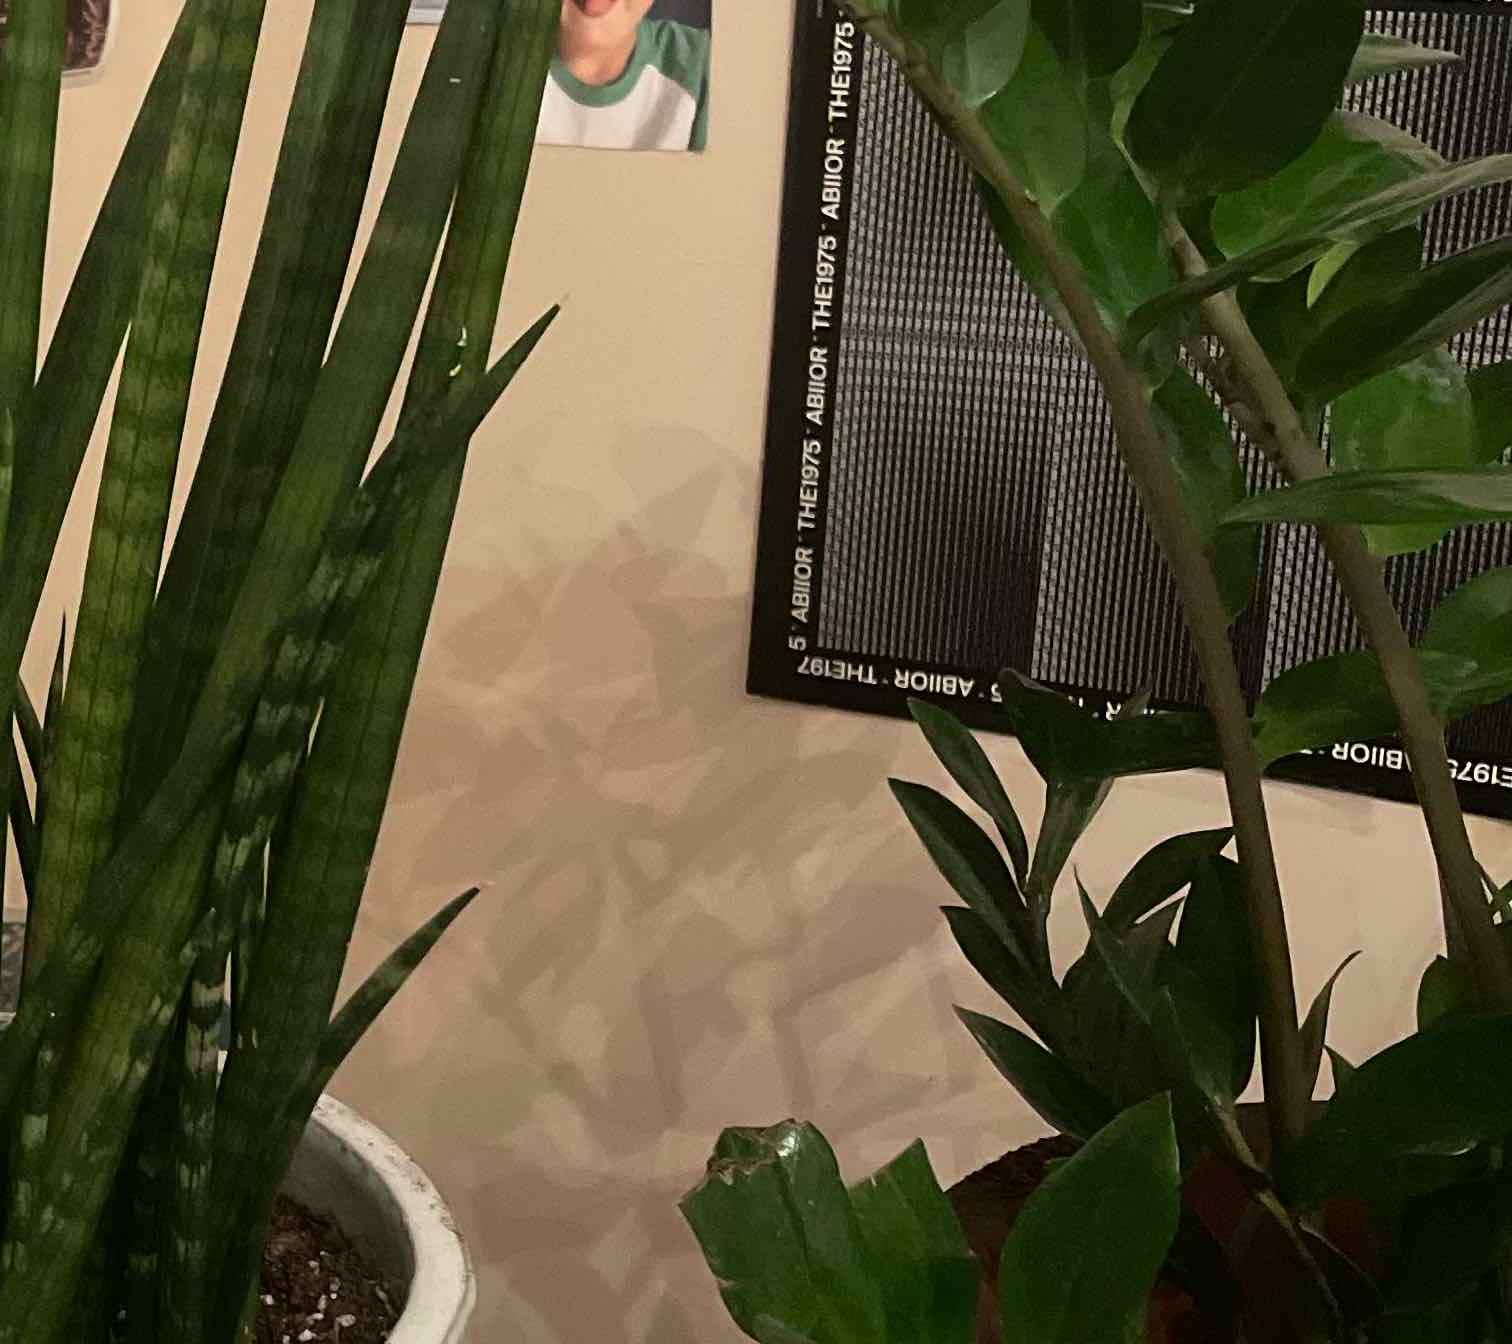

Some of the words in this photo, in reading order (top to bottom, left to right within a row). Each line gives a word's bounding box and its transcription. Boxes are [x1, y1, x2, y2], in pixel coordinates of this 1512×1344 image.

[827, 21, 856, 121] THE1975
[821, 138, 846, 222] ABIIOR
[811, 235, 838, 331] THE1975
[805, 346, 829, 427] ABIIOR
[797, 438, 822, 532] THE1975
[791, 546, 815, 624] ABIIOR
[796, 655, 878, 685] THE197
[893, 667, 975, 697] ABIIOR
